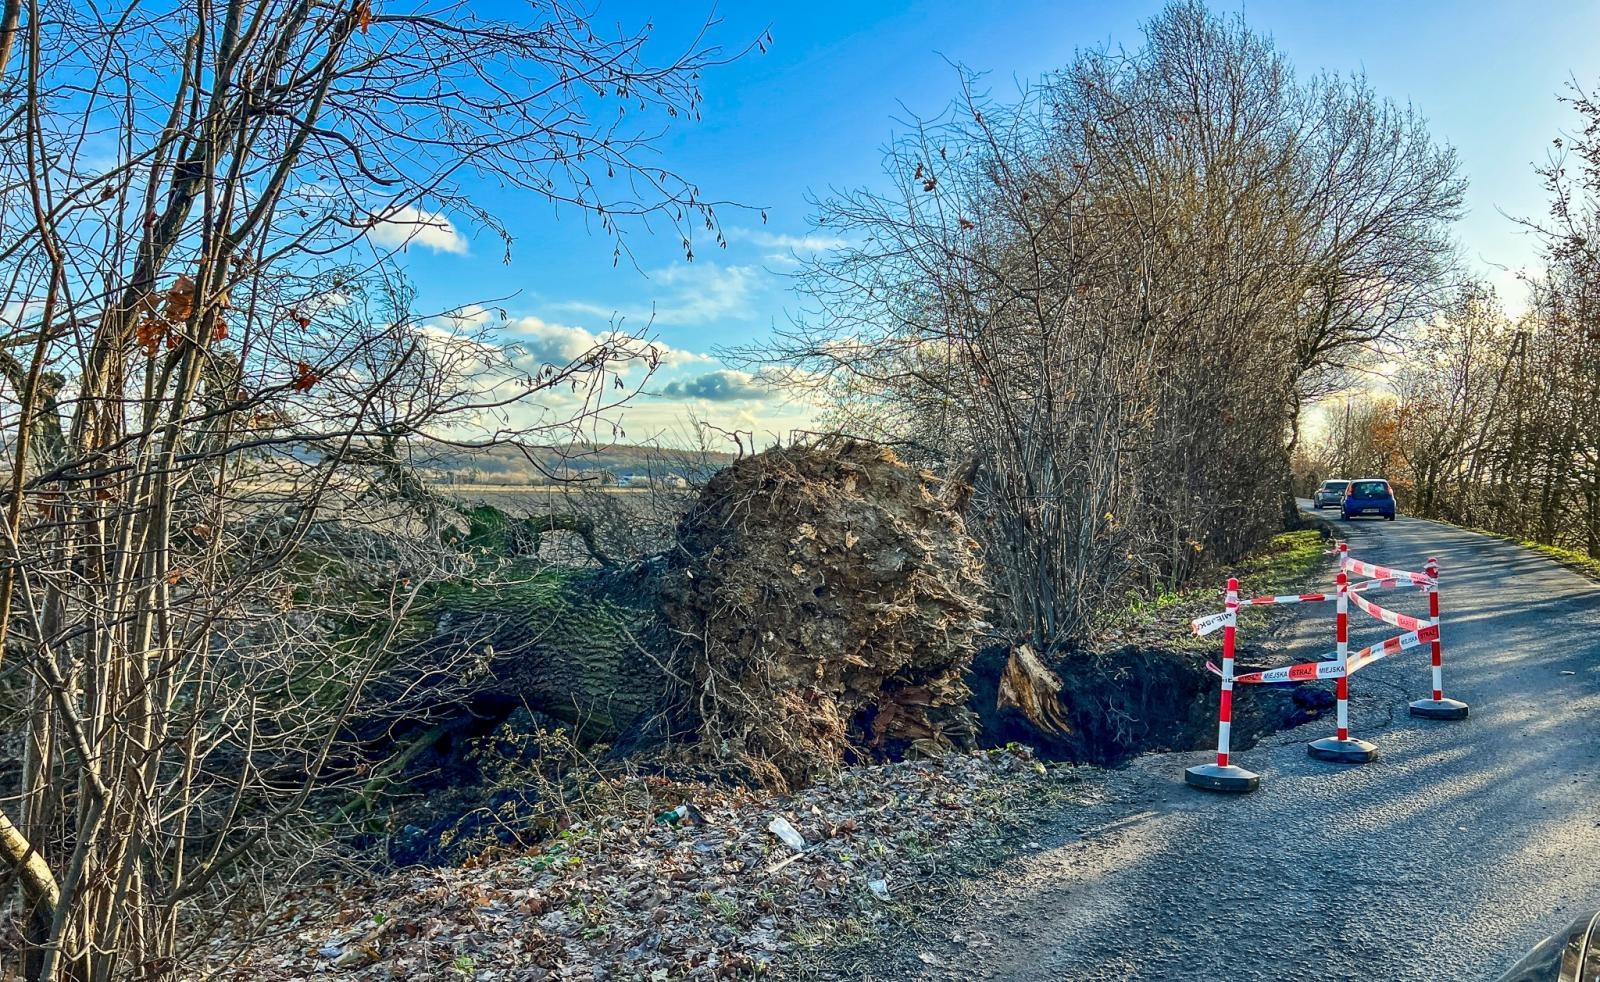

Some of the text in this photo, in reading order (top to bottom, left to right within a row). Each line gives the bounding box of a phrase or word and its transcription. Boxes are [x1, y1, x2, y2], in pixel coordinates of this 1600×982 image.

[1264, 671, 1288, 680] MIEJSKA
[1291, 667, 1312, 676] STRAŻ
[1319, 665, 1345, 674] MIEJSKA
